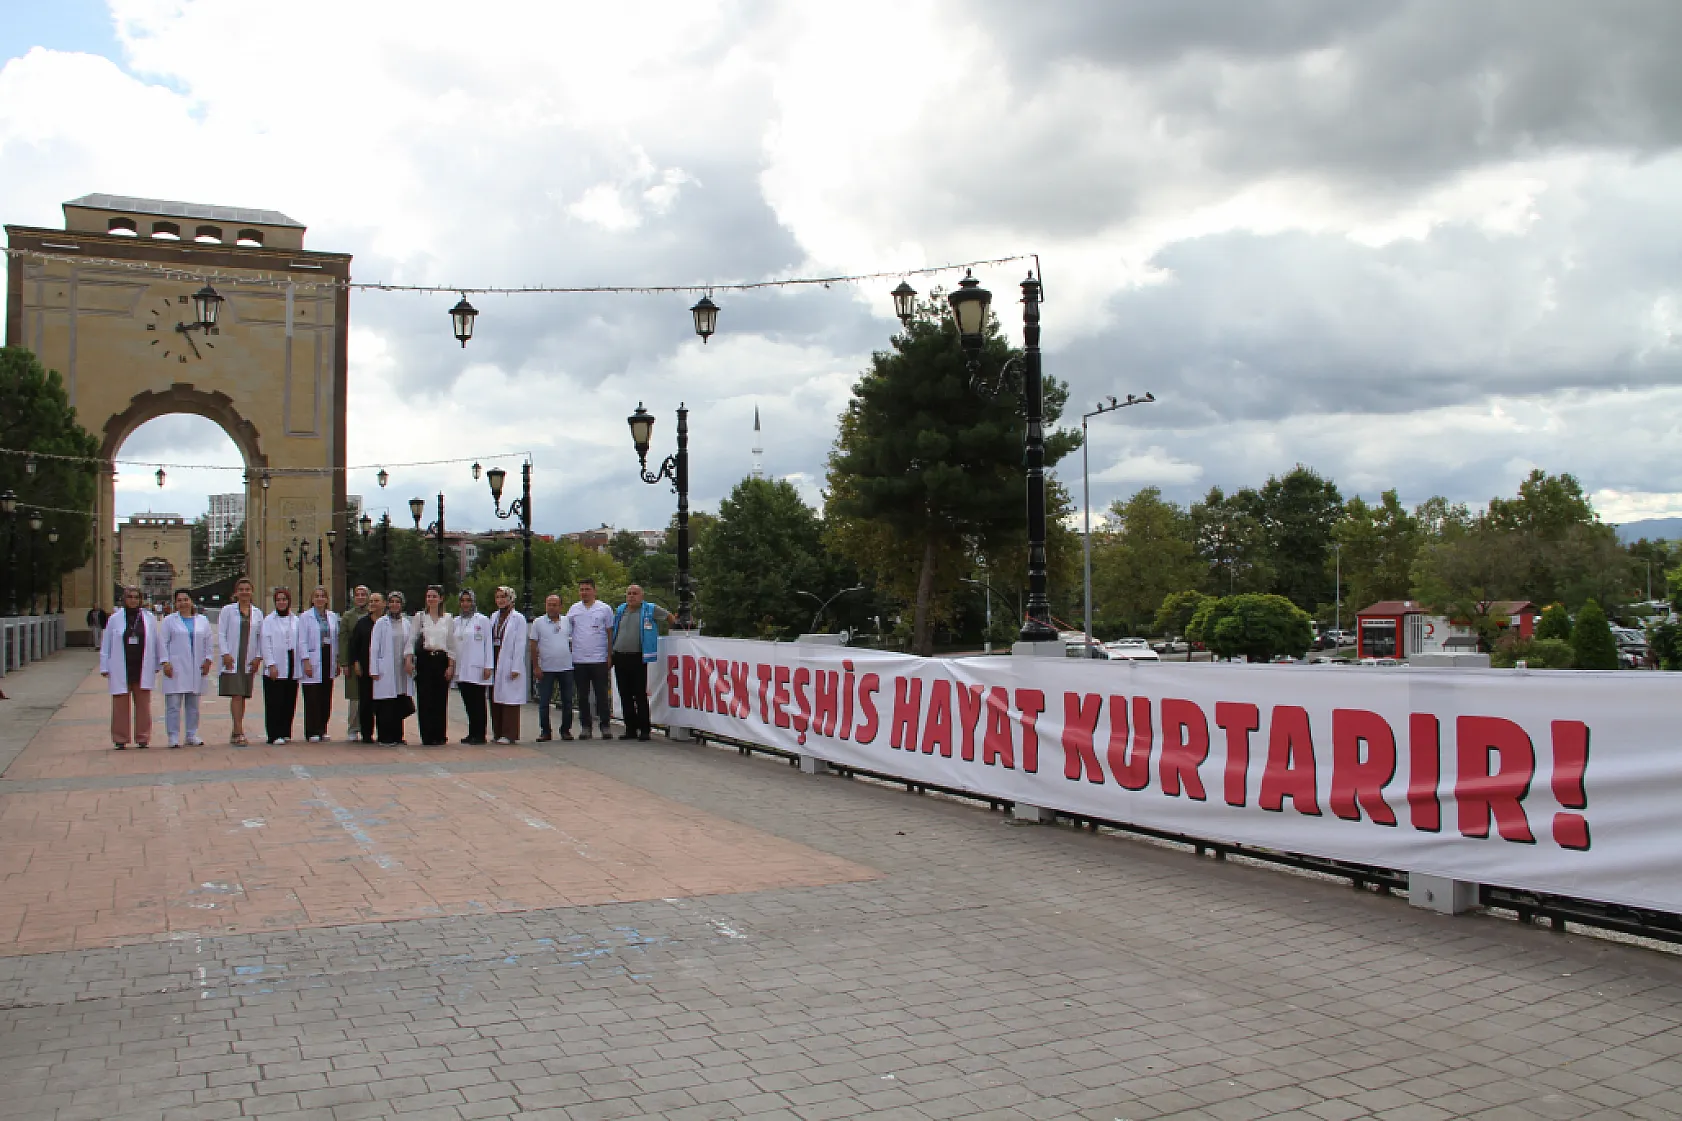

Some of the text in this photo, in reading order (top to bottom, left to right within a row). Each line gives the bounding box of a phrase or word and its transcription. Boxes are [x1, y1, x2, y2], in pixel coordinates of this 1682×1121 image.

[666, 655, 1591, 850] ERKEN TEŞHİS HAYAT KURTARIR!
